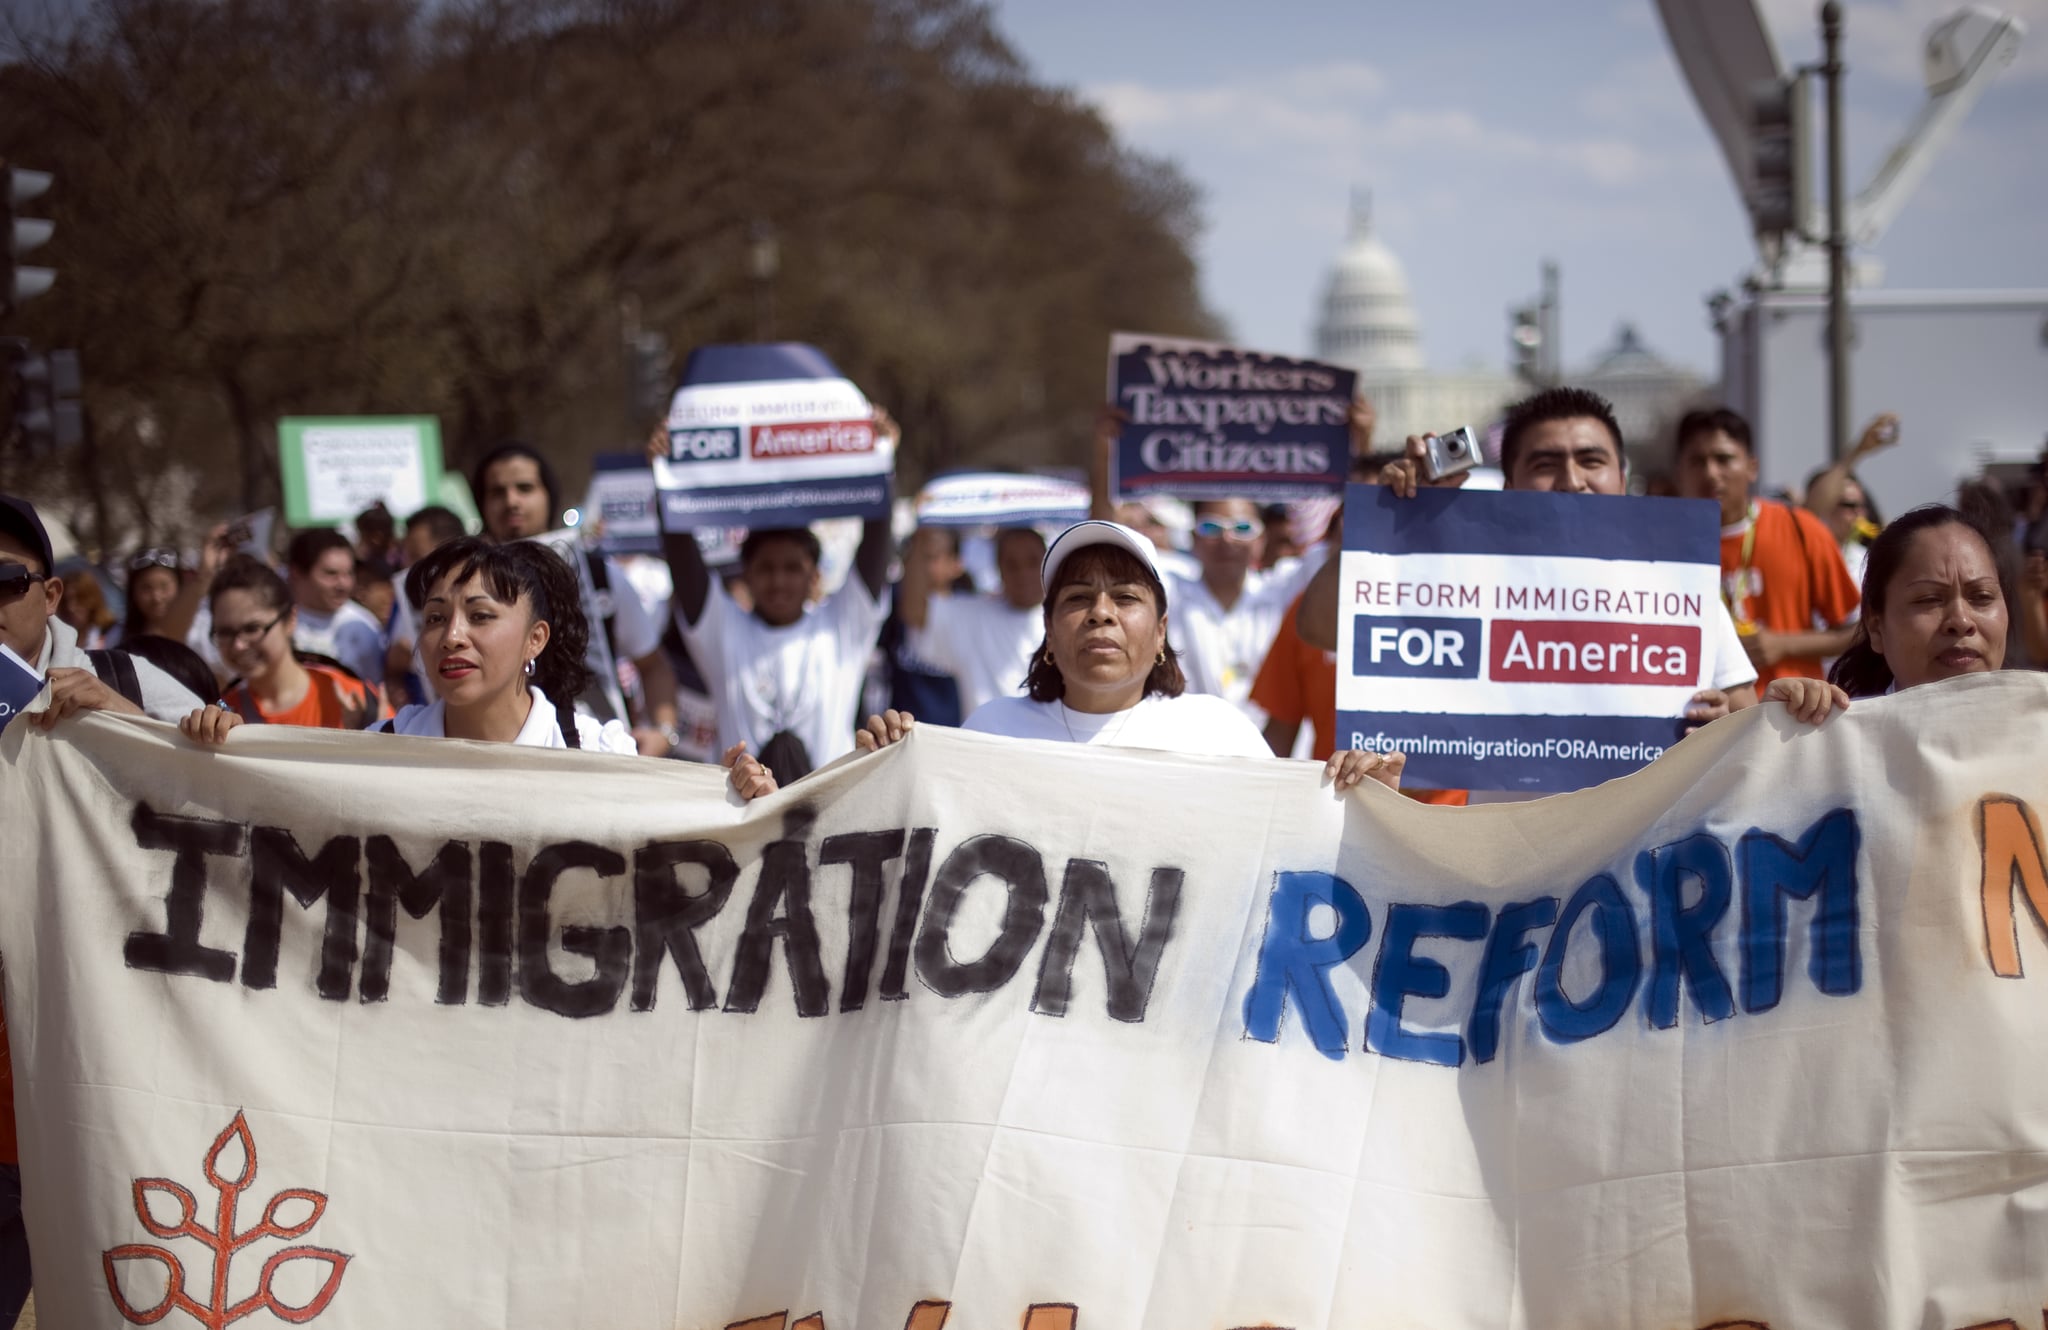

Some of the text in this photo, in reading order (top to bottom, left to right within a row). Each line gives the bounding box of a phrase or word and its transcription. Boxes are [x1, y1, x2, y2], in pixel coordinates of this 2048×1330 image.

[1145, 352, 1337, 392] Workers
[1120, 384, 1347, 435] Taxpayers
[671, 424, 874, 461] FOR America
[1140, 430, 1332, 474] Citizens
[1355, 580, 1701, 617] REFORM IMMIGRATION
[1370, 626, 1688, 676] FOR America
[124, 803, 1185, 1023] IMMIGRATION
[1243, 807, 1862, 1068] REFORM
